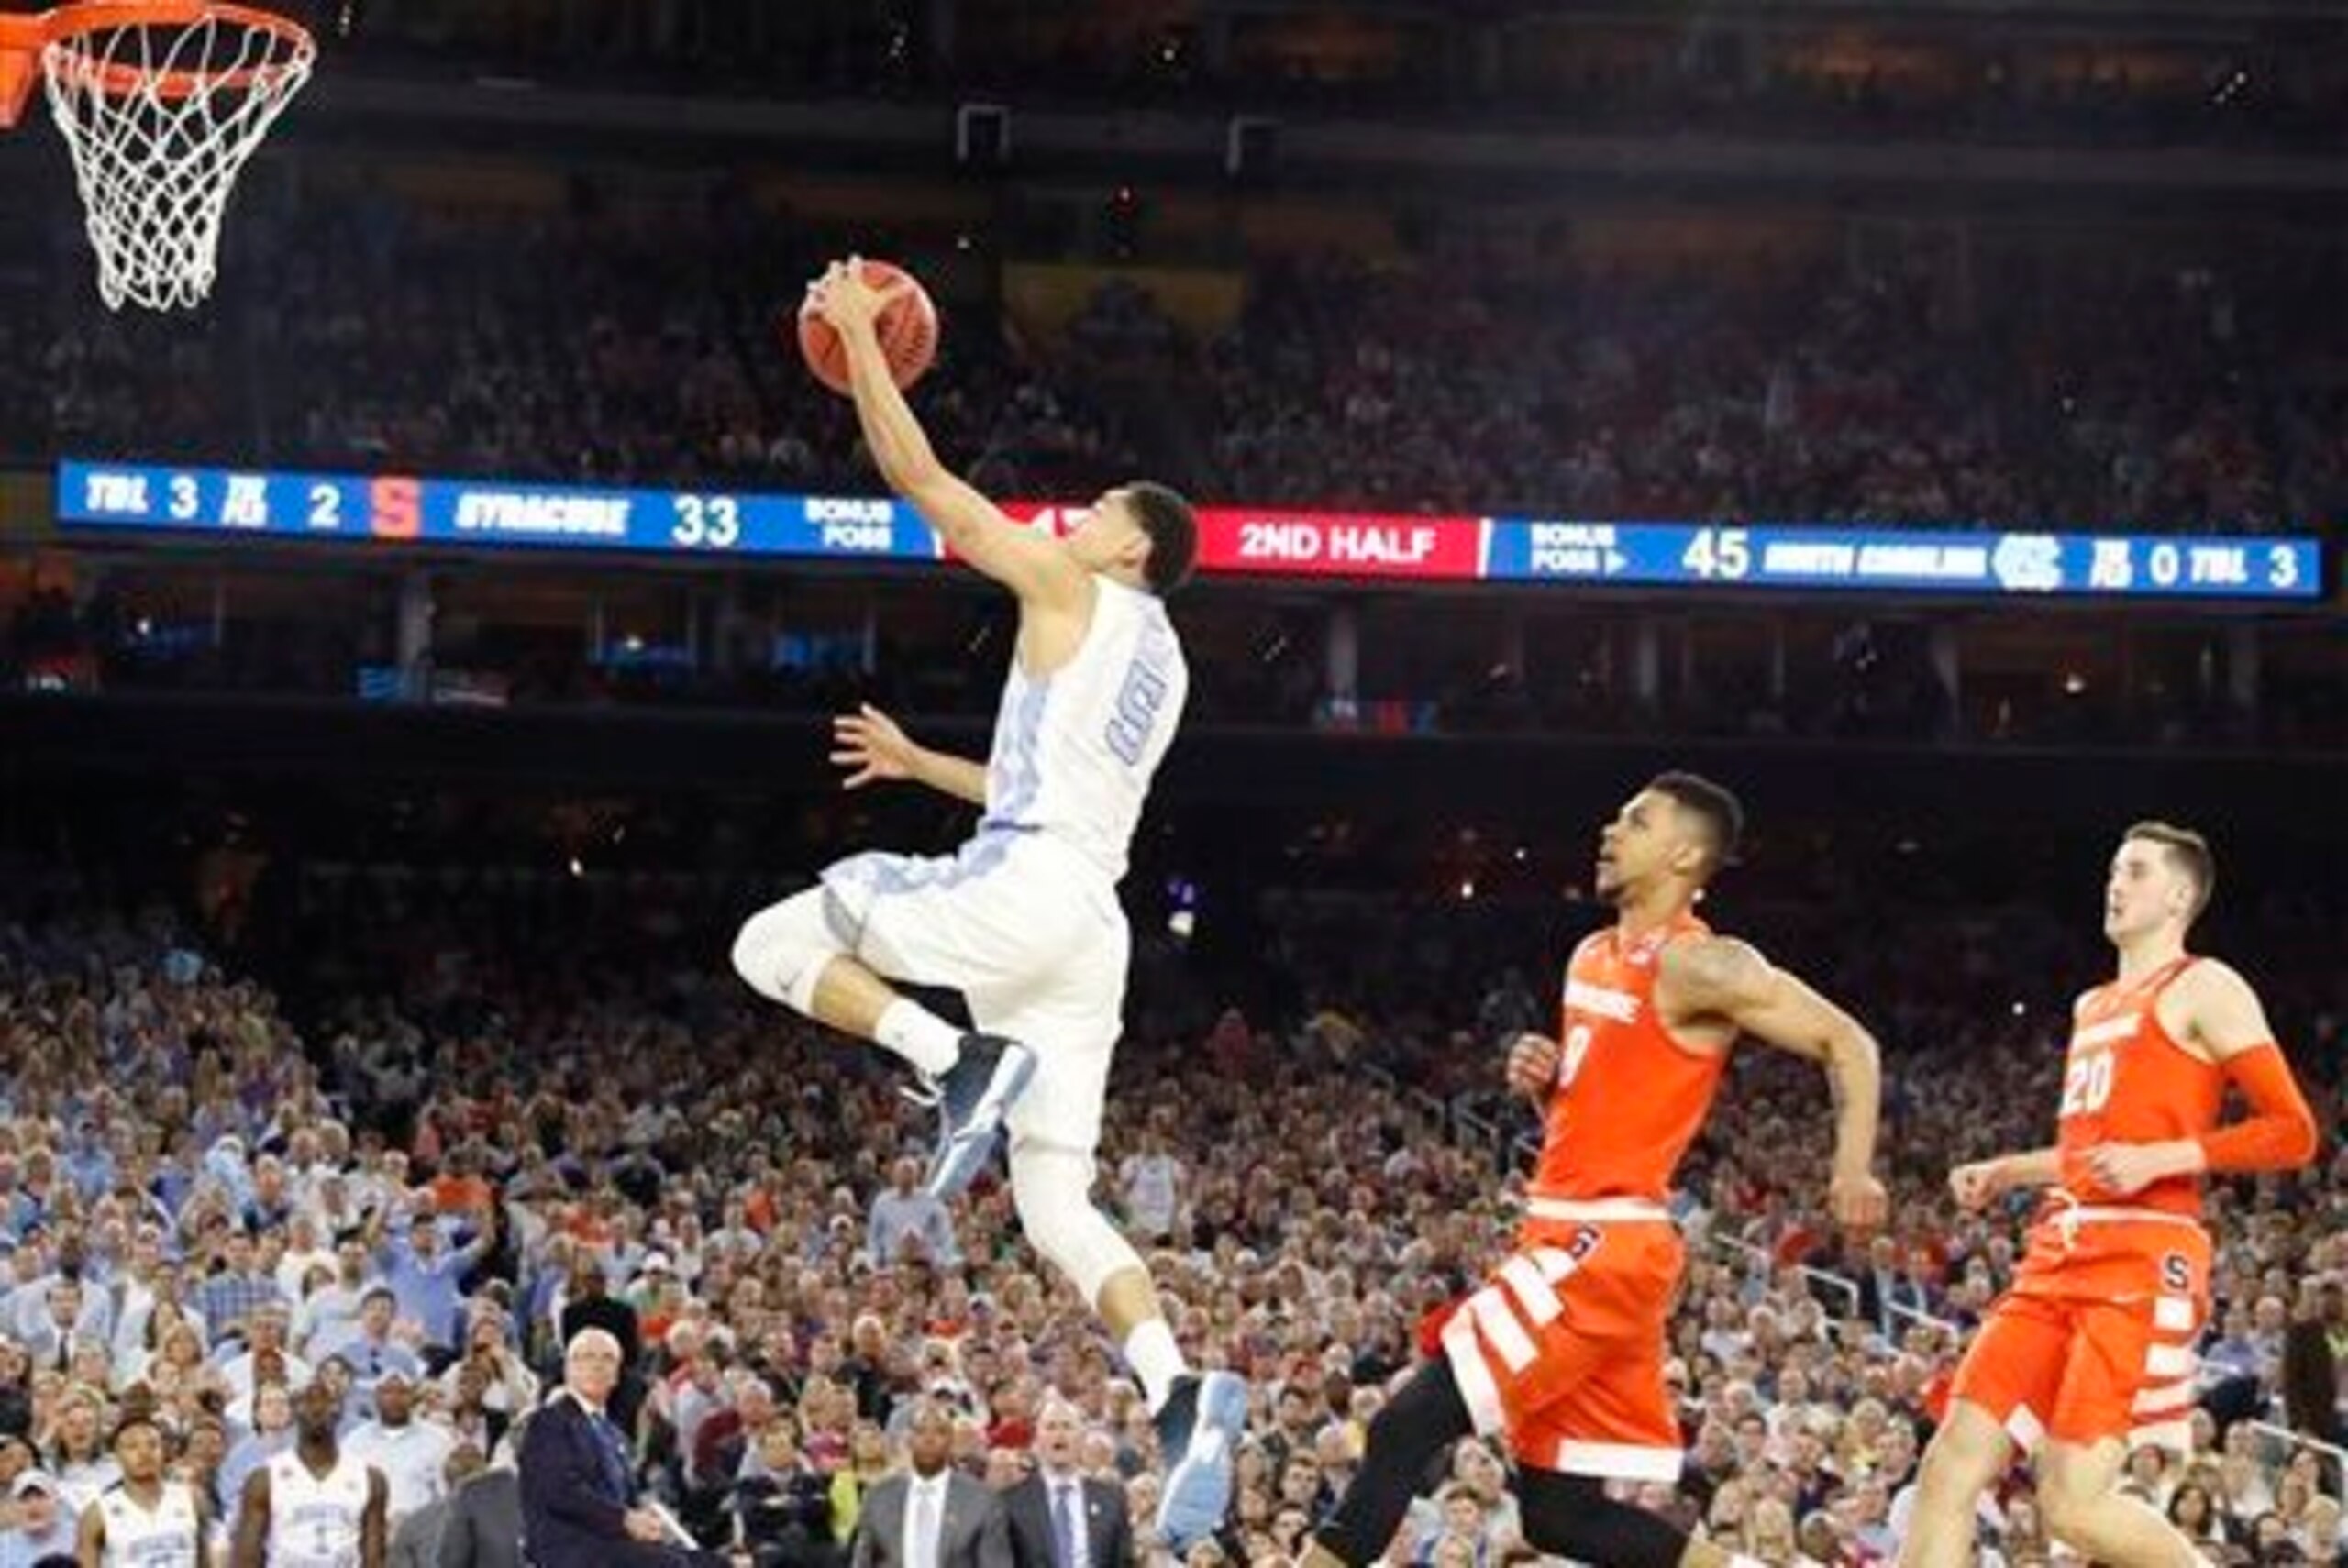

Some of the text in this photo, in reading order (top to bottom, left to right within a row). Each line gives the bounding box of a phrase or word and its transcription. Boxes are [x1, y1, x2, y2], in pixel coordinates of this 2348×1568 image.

[170, 476, 198, 518] 3
[309, 484, 340, 528] 2
[371, 477, 420, 537] S
[672, 495, 739, 547] 33
[1240, 523, 1436, 564] 2ND HALF
[1682, 526, 1750, 579] 45
[2150, 545, 2179, 586] 0
[2269, 545, 2298, 588] 3
[2059, 1051, 2115, 1116] 20
[2162, 1253, 2190, 1292] S
